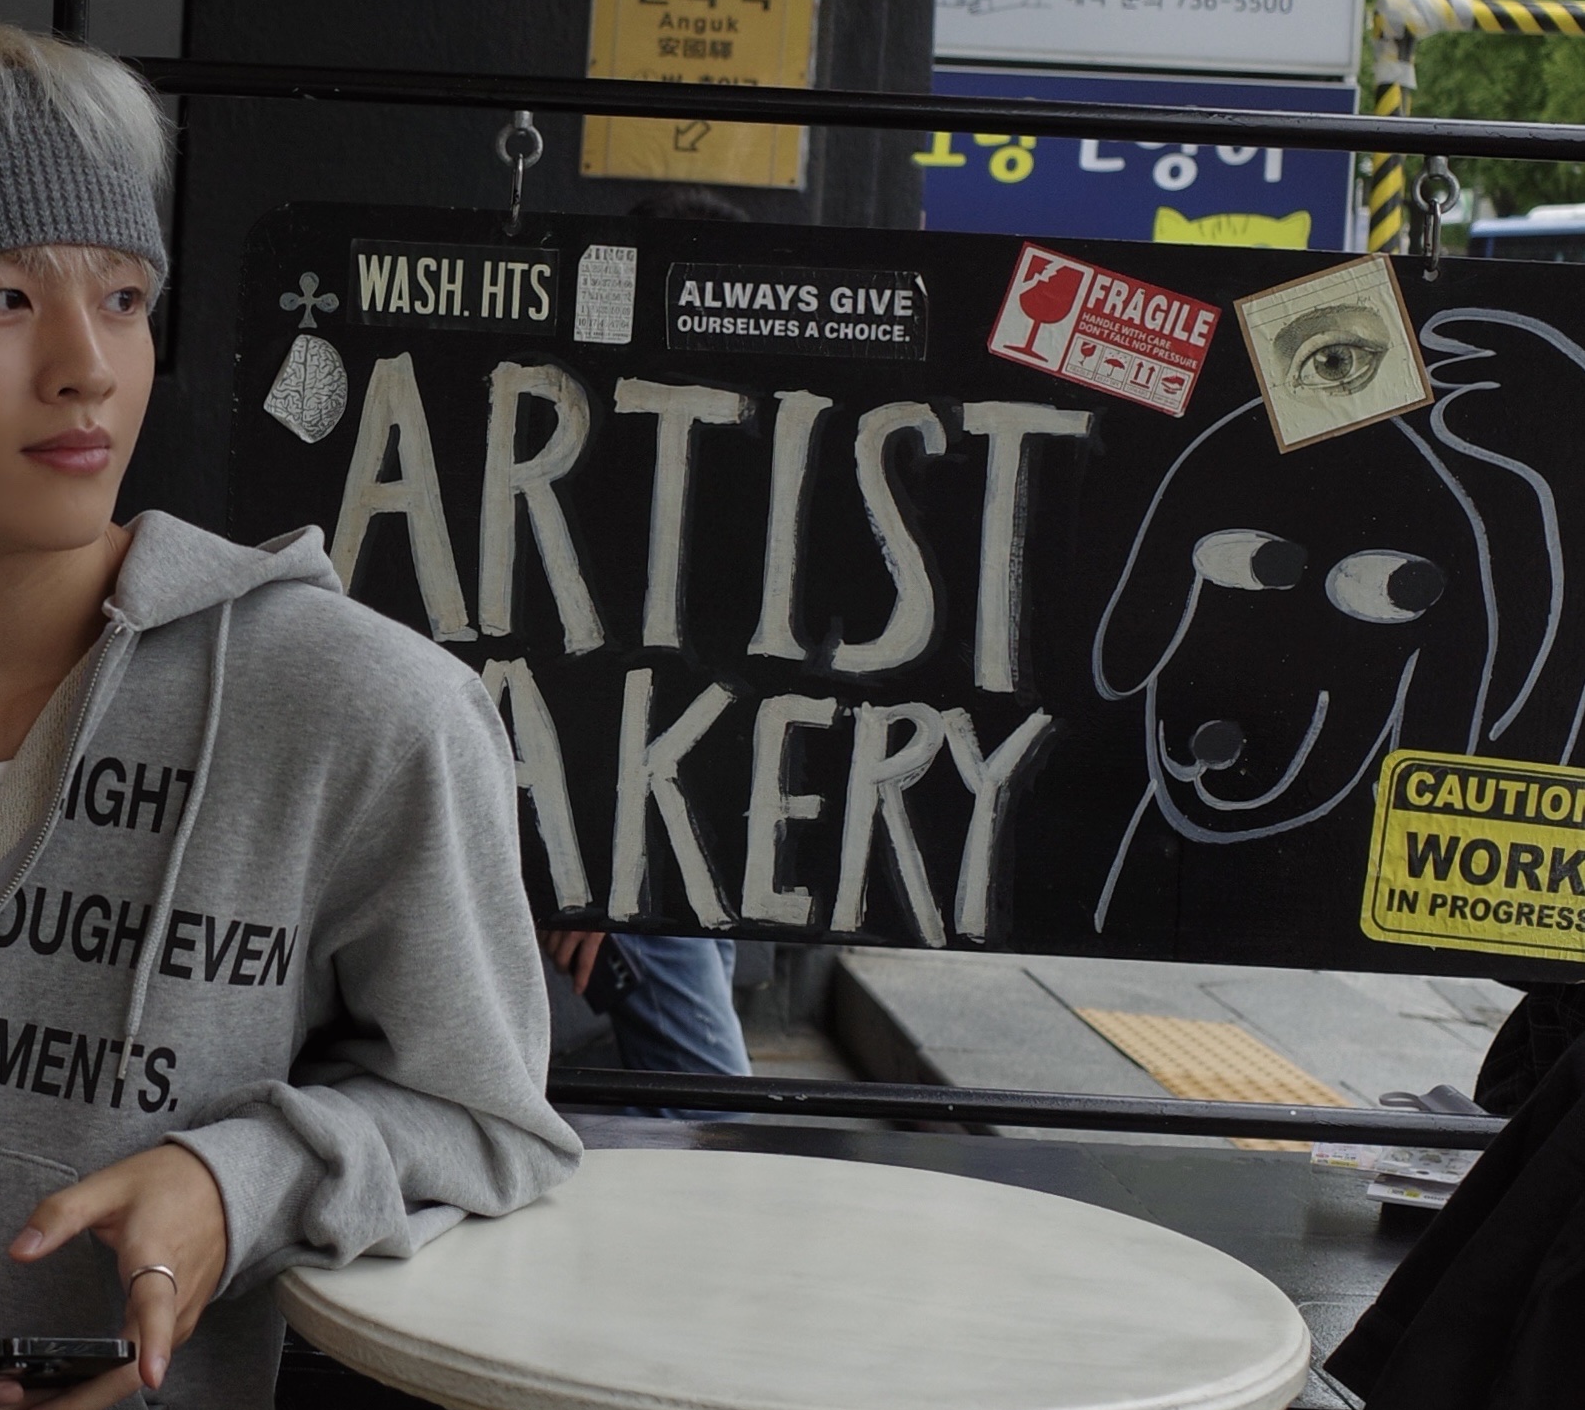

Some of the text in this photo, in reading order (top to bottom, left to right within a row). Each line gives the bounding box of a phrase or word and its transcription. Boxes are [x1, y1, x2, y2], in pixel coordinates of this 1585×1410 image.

[660, 13, 739, 34] Anguk
[358, 253, 552, 321] WASH. HTS
[678, 280, 914, 317] ALWAYS GIVE
[1087, 273, 1216, 348] FRAGILE
[677, 315, 911, 342] OURSELVES A CHOICE.
[1078, 321, 1198, 370] DON'T FALL NOT PRESSURE
[1082, 312, 1172, 351] HANDLE WITH CARE
[330, 352, 1092, 693] ARTIST
[1406, 831, 1585, 897] WORK
[1386, 888, 1420, 914] IN
[159, 909, 299, 987] EVEN
